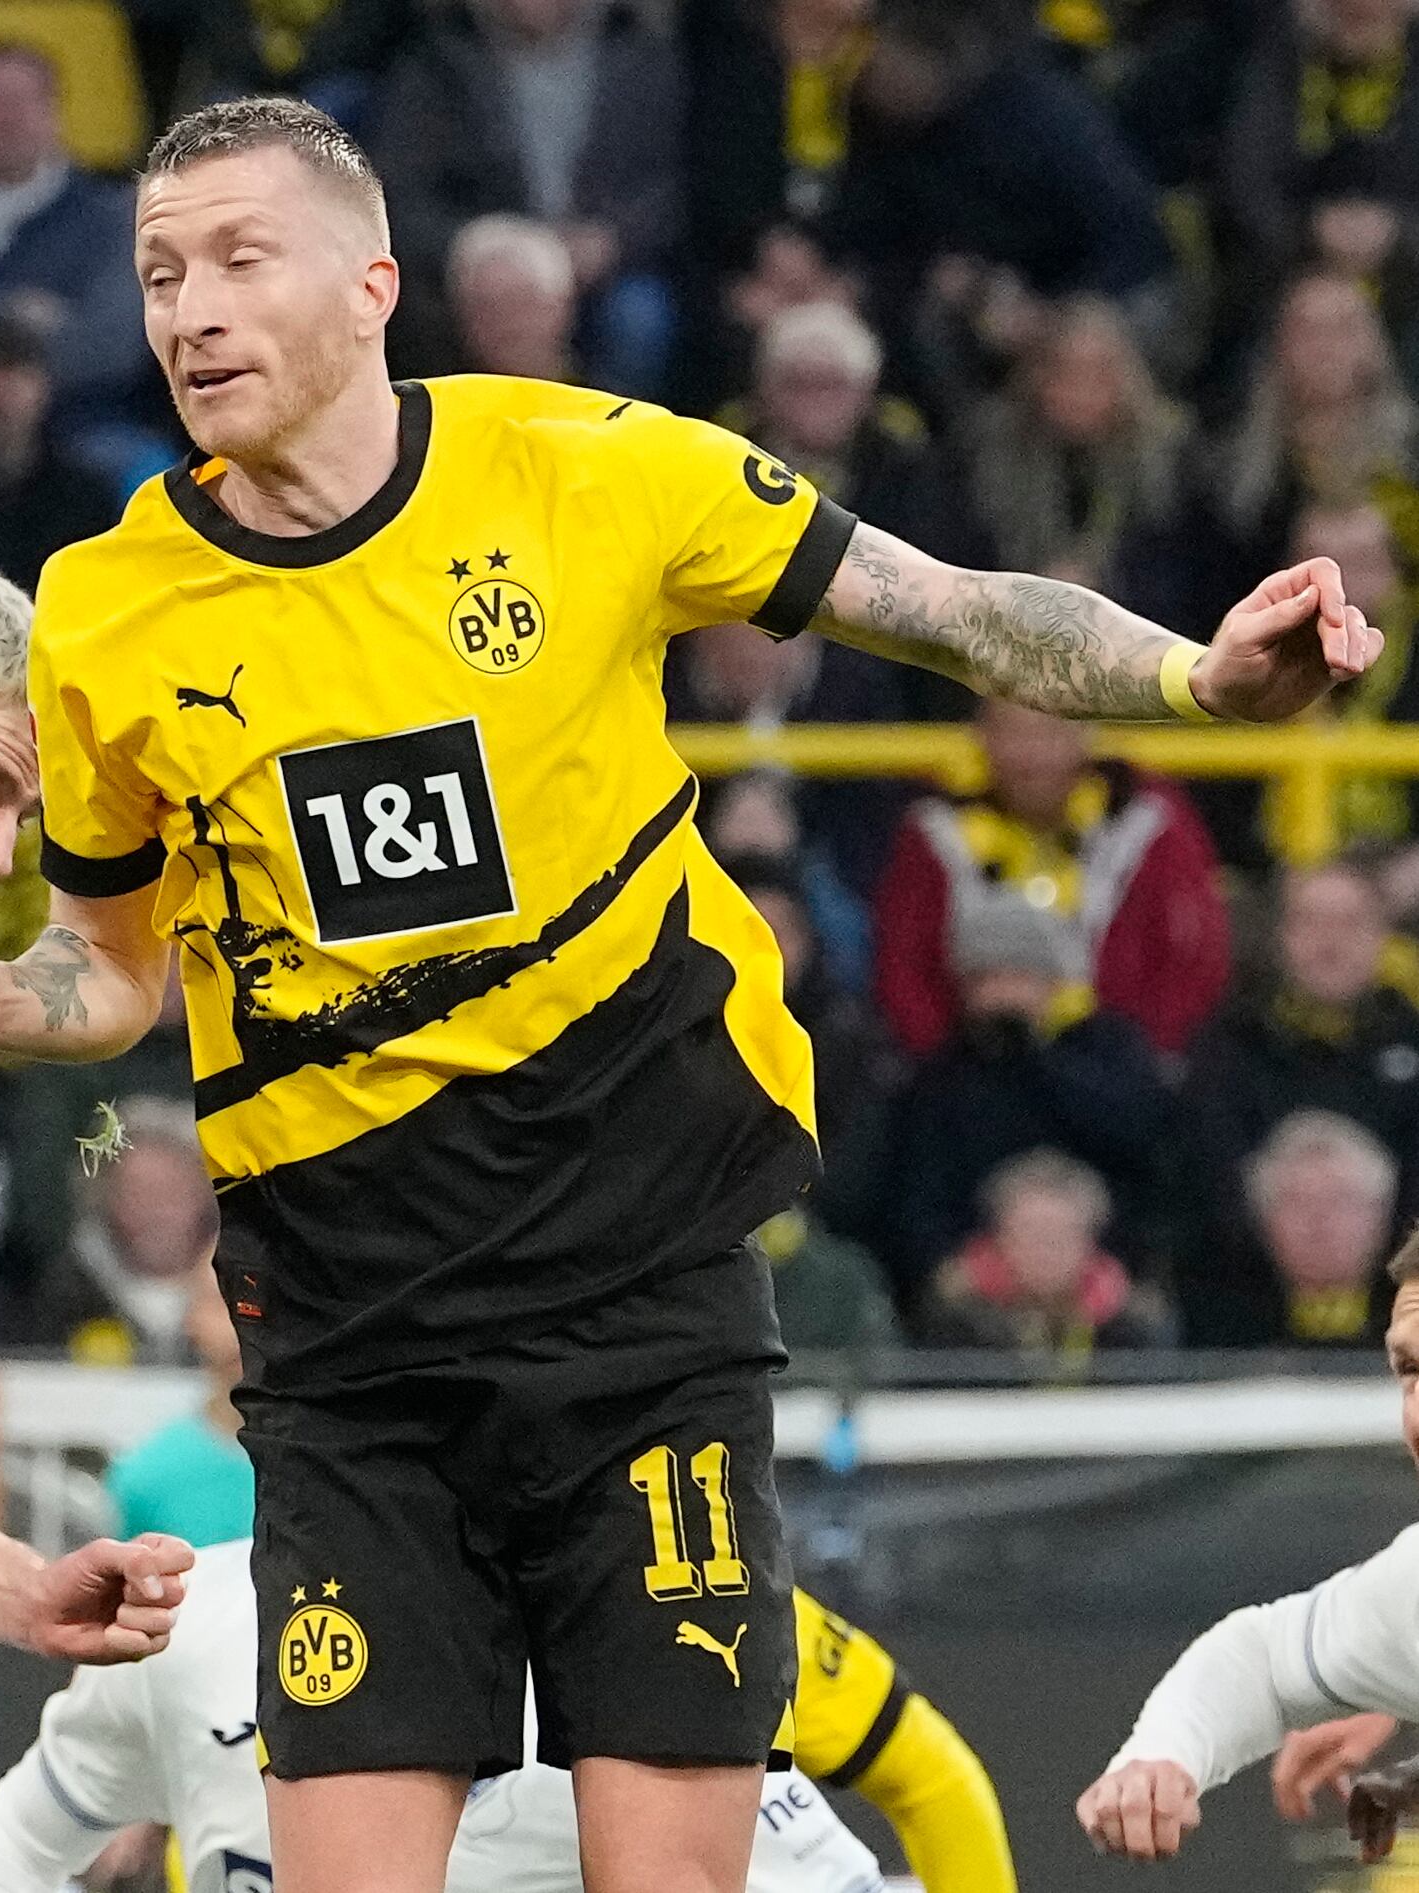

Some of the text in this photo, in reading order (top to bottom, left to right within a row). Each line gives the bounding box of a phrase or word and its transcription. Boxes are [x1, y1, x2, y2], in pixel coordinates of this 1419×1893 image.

[459, 587, 536, 653] BVB
[491, 643, 519, 666] 09
[306, 771, 479, 886] 1&1
[630, 1442, 751, 1602] 11
[289, 1616, 354, 1677] BVB
[306, 1673, 331, 1694] 09
